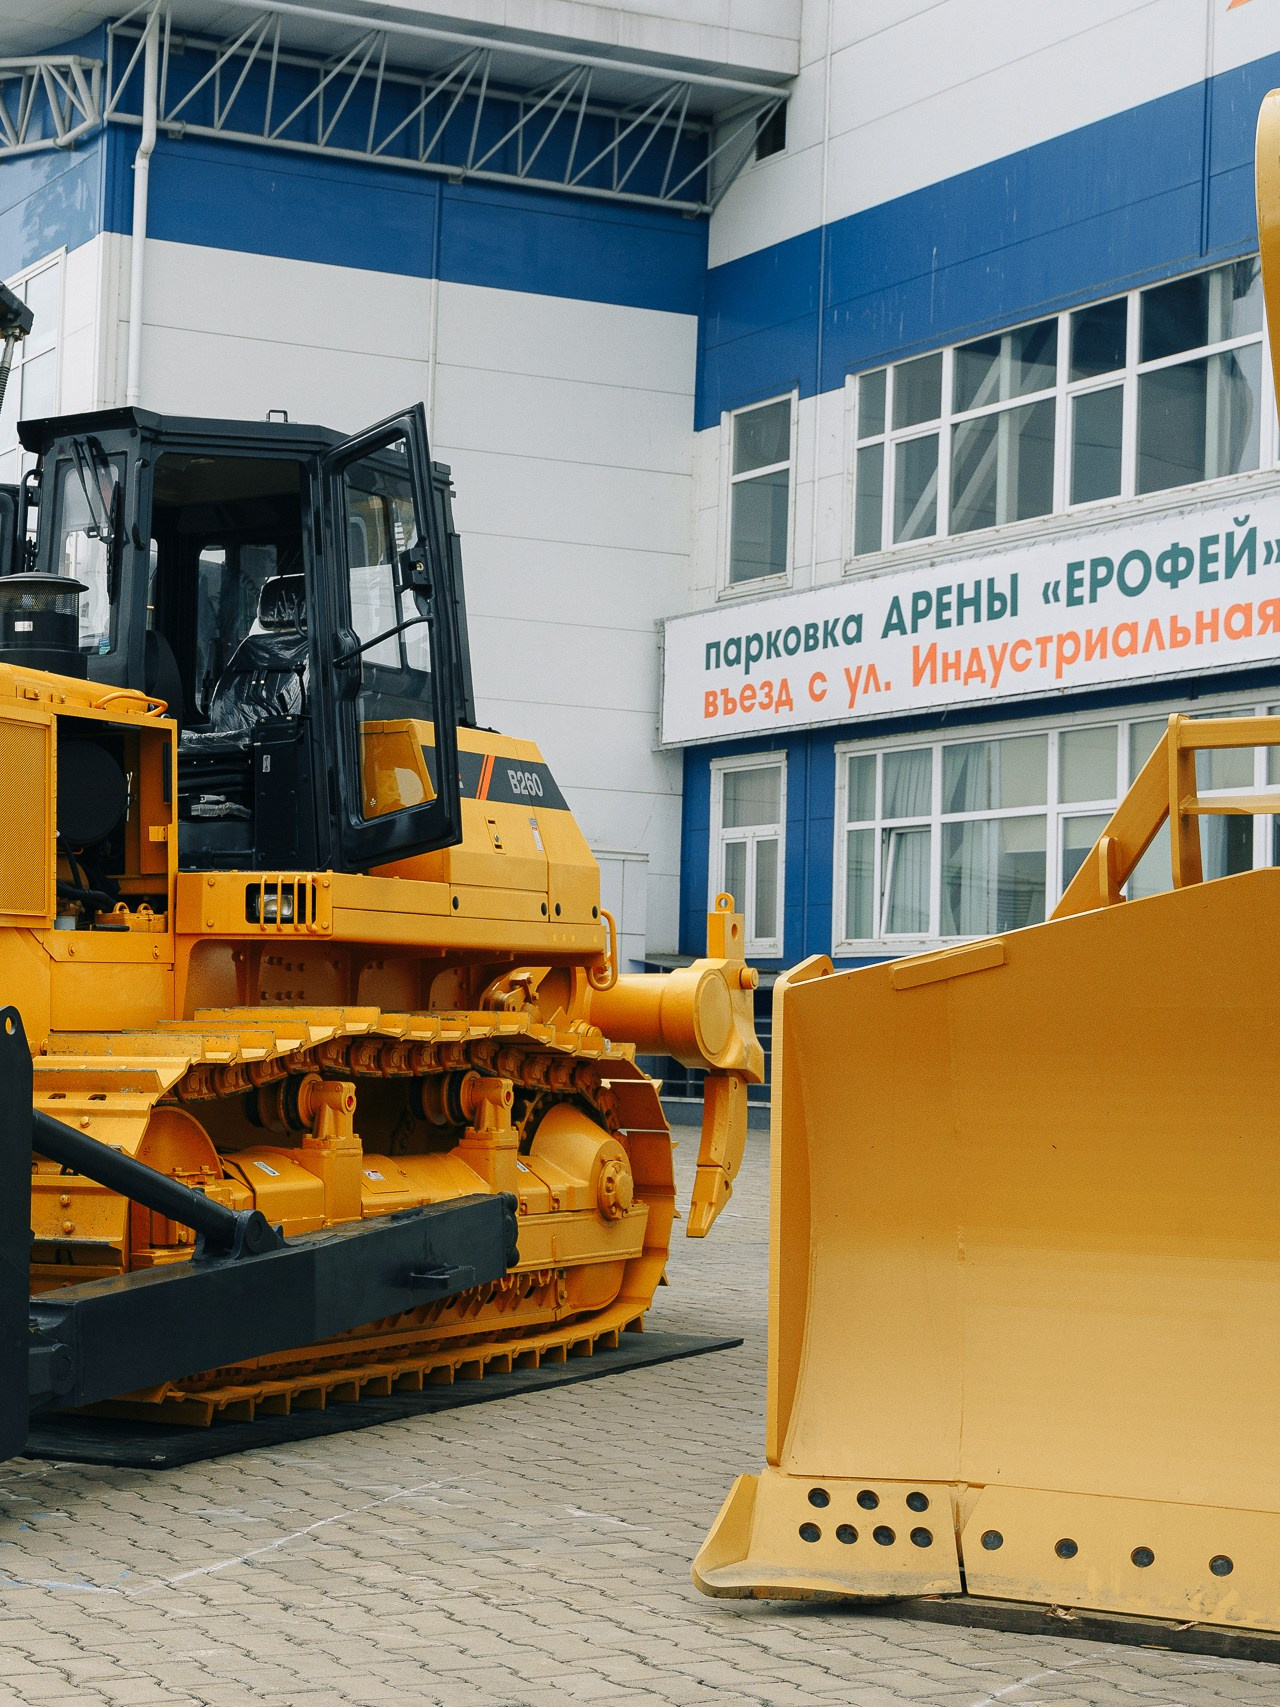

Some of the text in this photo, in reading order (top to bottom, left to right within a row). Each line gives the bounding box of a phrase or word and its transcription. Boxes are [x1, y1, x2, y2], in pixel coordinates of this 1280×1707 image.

[704, 597, 1280, 718] въезд с ул. Индустриальная
[705, 613, 863, 675] парковка
[881, 573, 1019, 639] АРЕНЫ
[507, 769, 543, 797] B260
